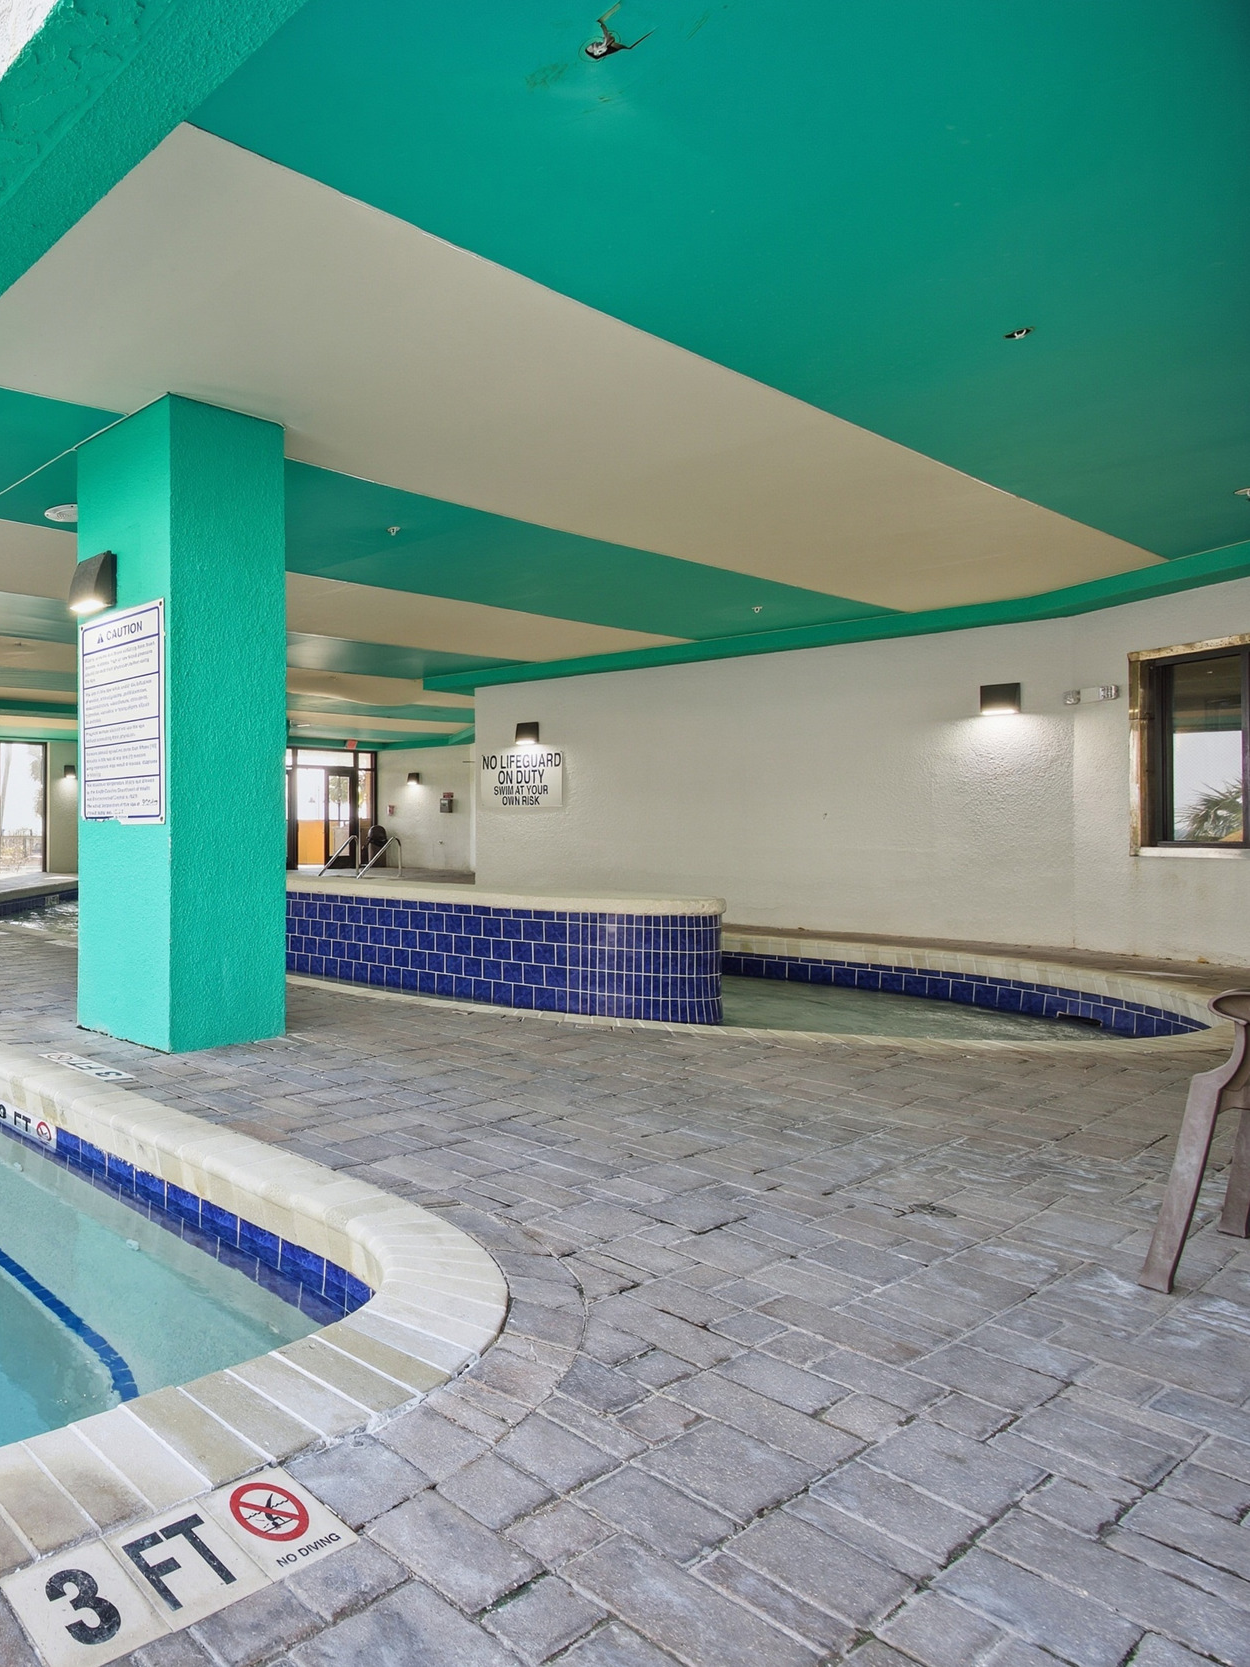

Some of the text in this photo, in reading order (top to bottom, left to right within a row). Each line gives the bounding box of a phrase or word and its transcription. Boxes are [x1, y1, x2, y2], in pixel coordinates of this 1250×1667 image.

[106, 620, 143, 641] CAUTION
[482, 753, 561, 770] NO LIFEGUARD
[498, 769, 545, 785] ON DUTY
[493, 785, 549, 796] SWIM AT YOUR
[502, 795, 540, 806] OWN RISK
[276, 1533, 341, 1567] NO DIVING
[45, 1513, 237, 1645] 3 FT
